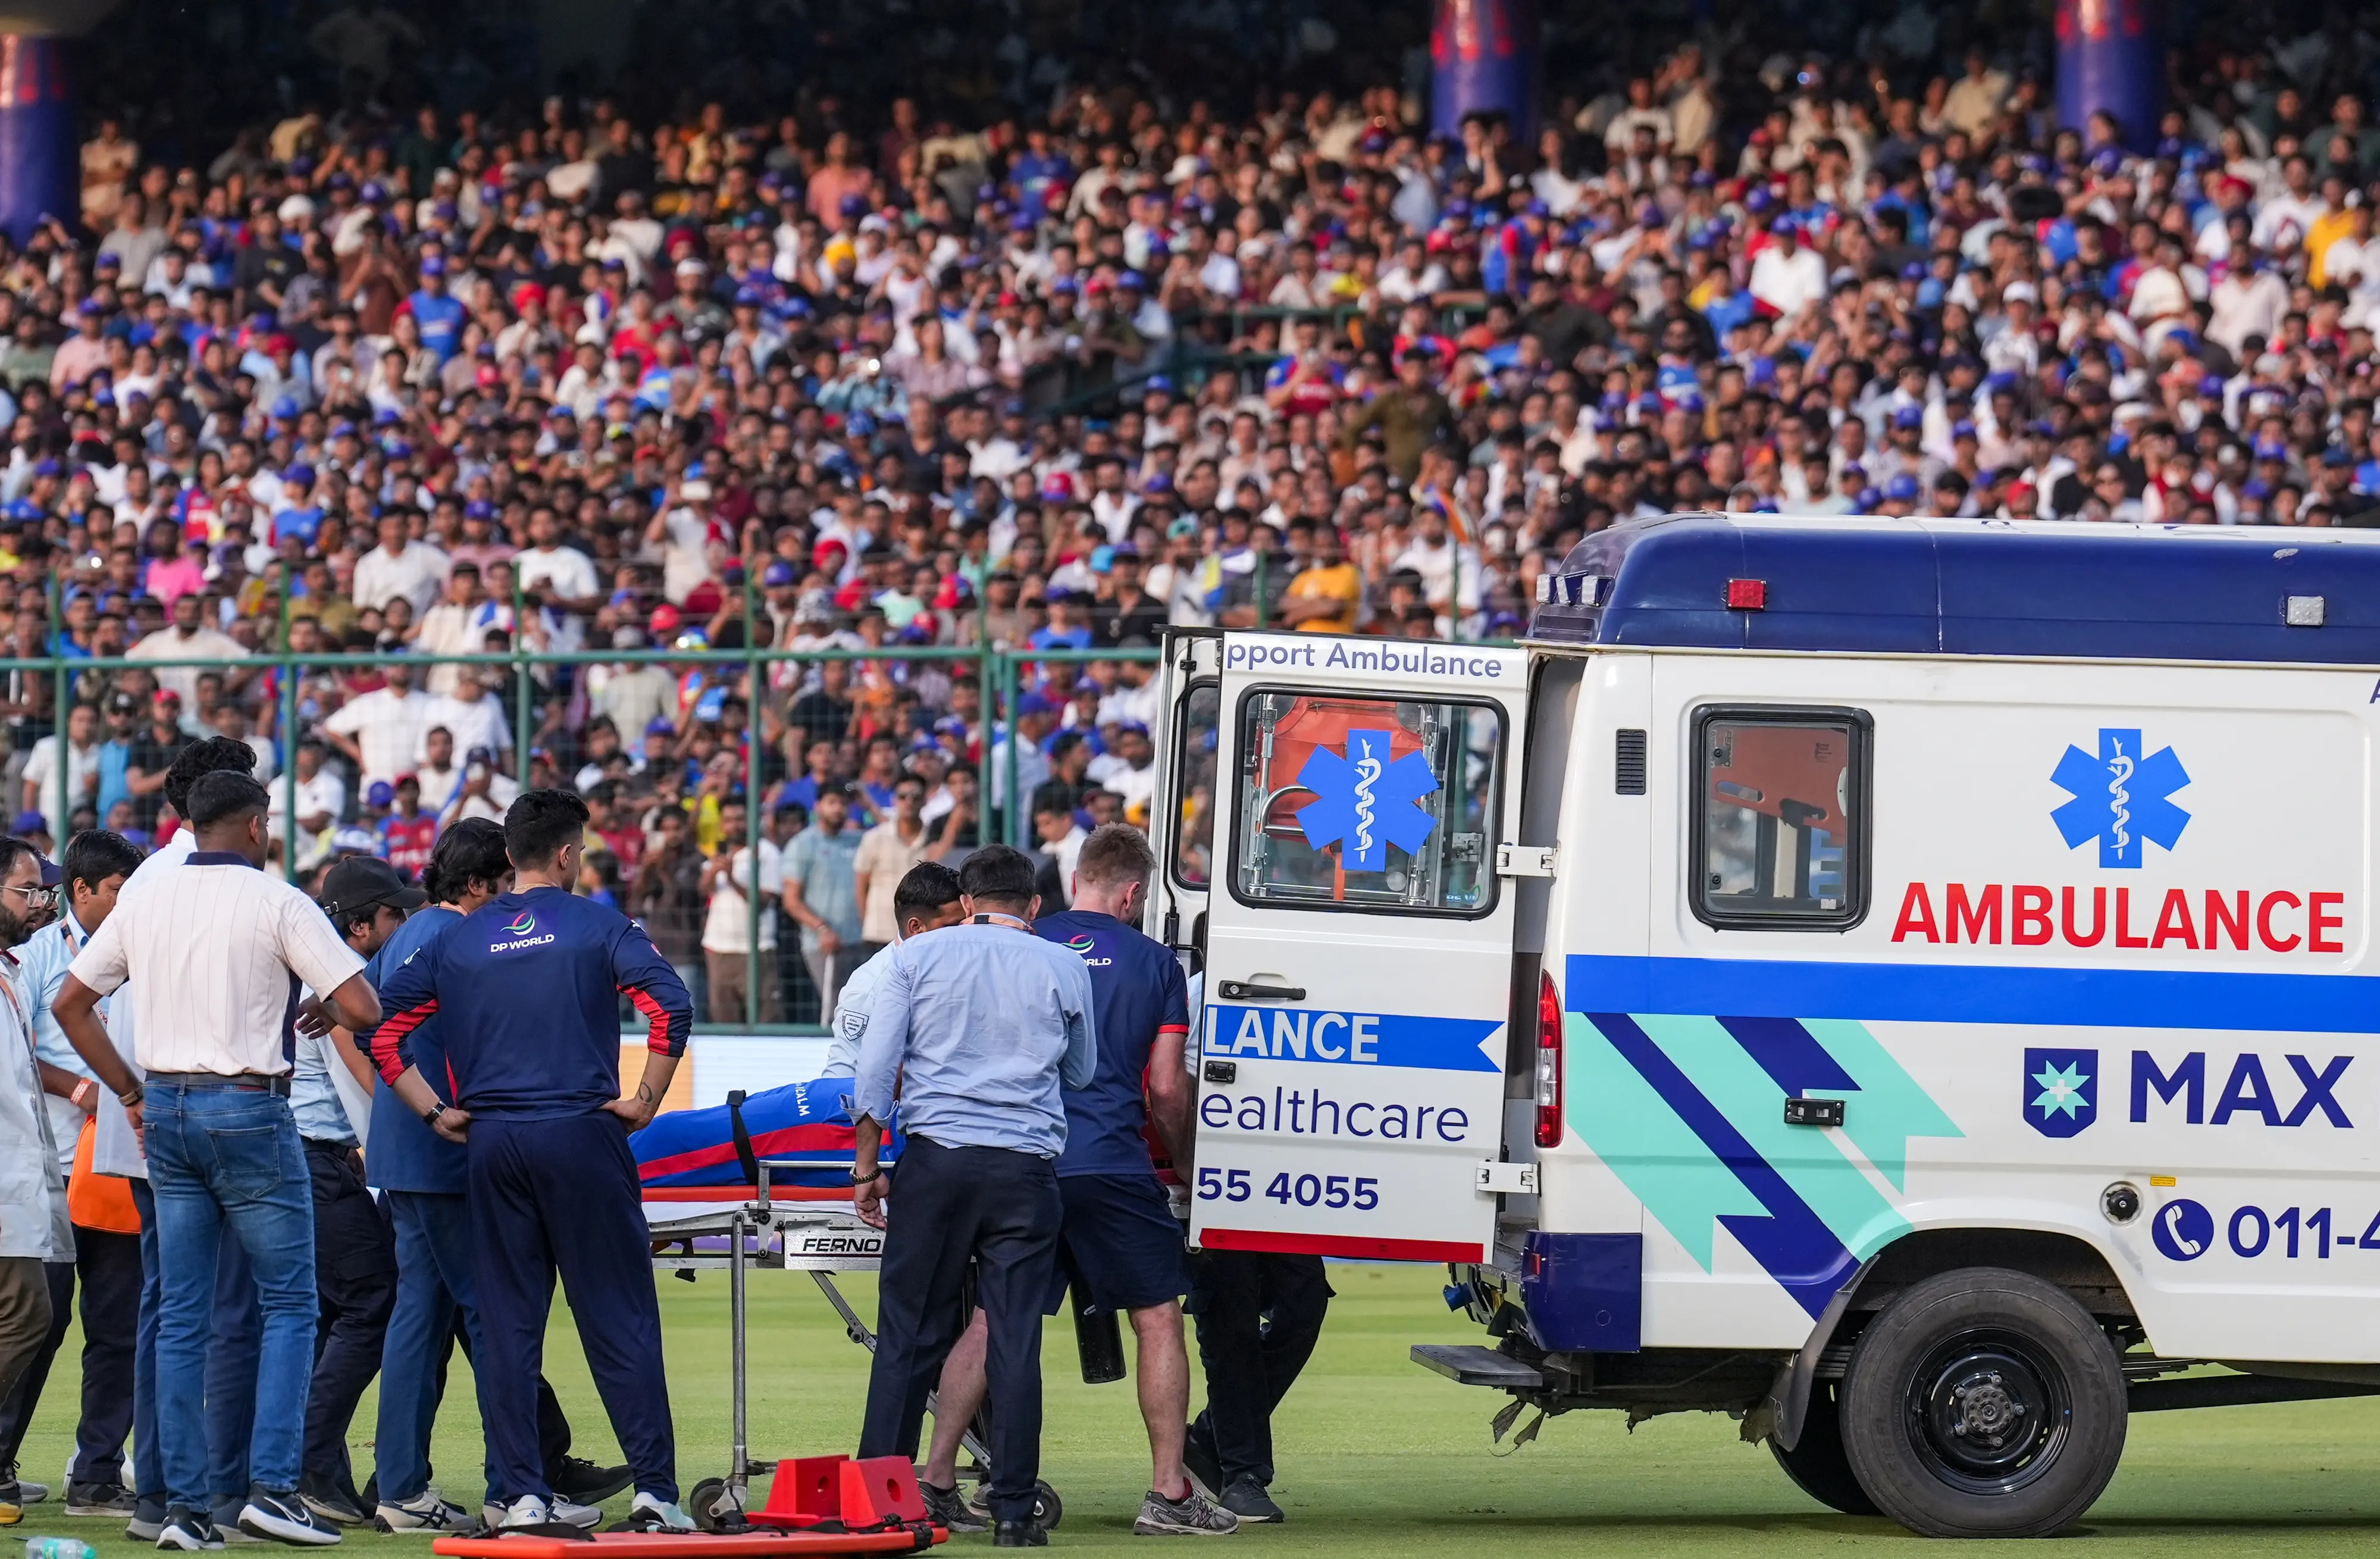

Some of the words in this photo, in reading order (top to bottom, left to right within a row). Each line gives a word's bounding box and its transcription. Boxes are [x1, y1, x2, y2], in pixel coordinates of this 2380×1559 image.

[1227, 644, 1315, 671] pport
[1326, 643, 1502, 678] Ambulance
[1891, 882, 2344, 954] AMBULANCE
[491, 943, 508, 952] DP
[509, 934, 554, 949] WORLD
[1083, 958, 1112, 967] RLD
[1204, 1007, 1380, 1063] LANCE
[2130, 1050, 2354, 1129] MAX
[1200, 1087, 1469, 1142] ealthcare
[1197, 1167, 1252, 1202] 55
[1266, 1172, 1379, 1210] 4055
[803, 1238, 881, 1252] FERNO
